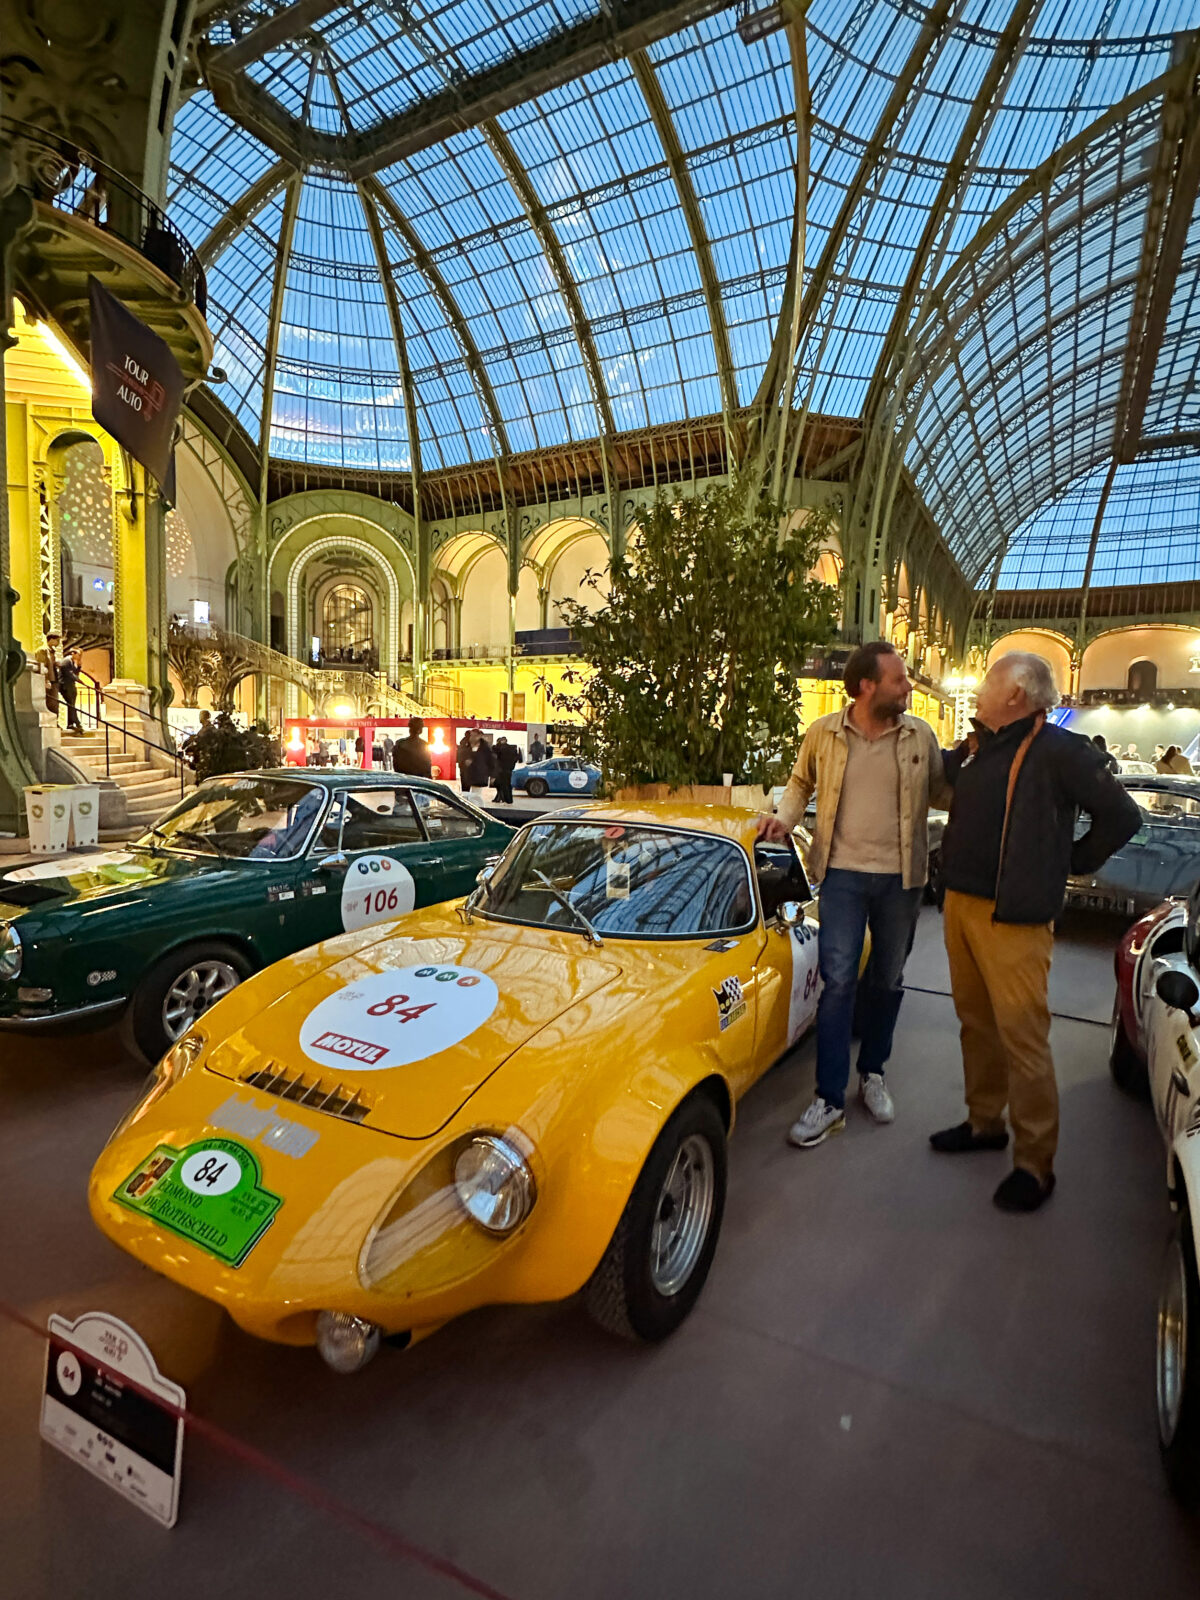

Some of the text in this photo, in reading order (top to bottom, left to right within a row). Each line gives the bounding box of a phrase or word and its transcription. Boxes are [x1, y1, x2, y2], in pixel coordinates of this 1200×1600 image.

[124, 354, 149, 387] TOUR
[116, 384, 143, 412] AUTO
[364, 887, 398, 915] 106
[804, 963, 820, 1001] 84
[366, 994, 438, 1024] 84
[315, 1033, 383, 1062] MOTUL
[193, 1157, 229, 1188] 84
[157, 1179, 204, 1209] EDMOND
[157, 1201, 229, 1248] ROTHSCHILD
[62, 1365, 76, 1382] 84
